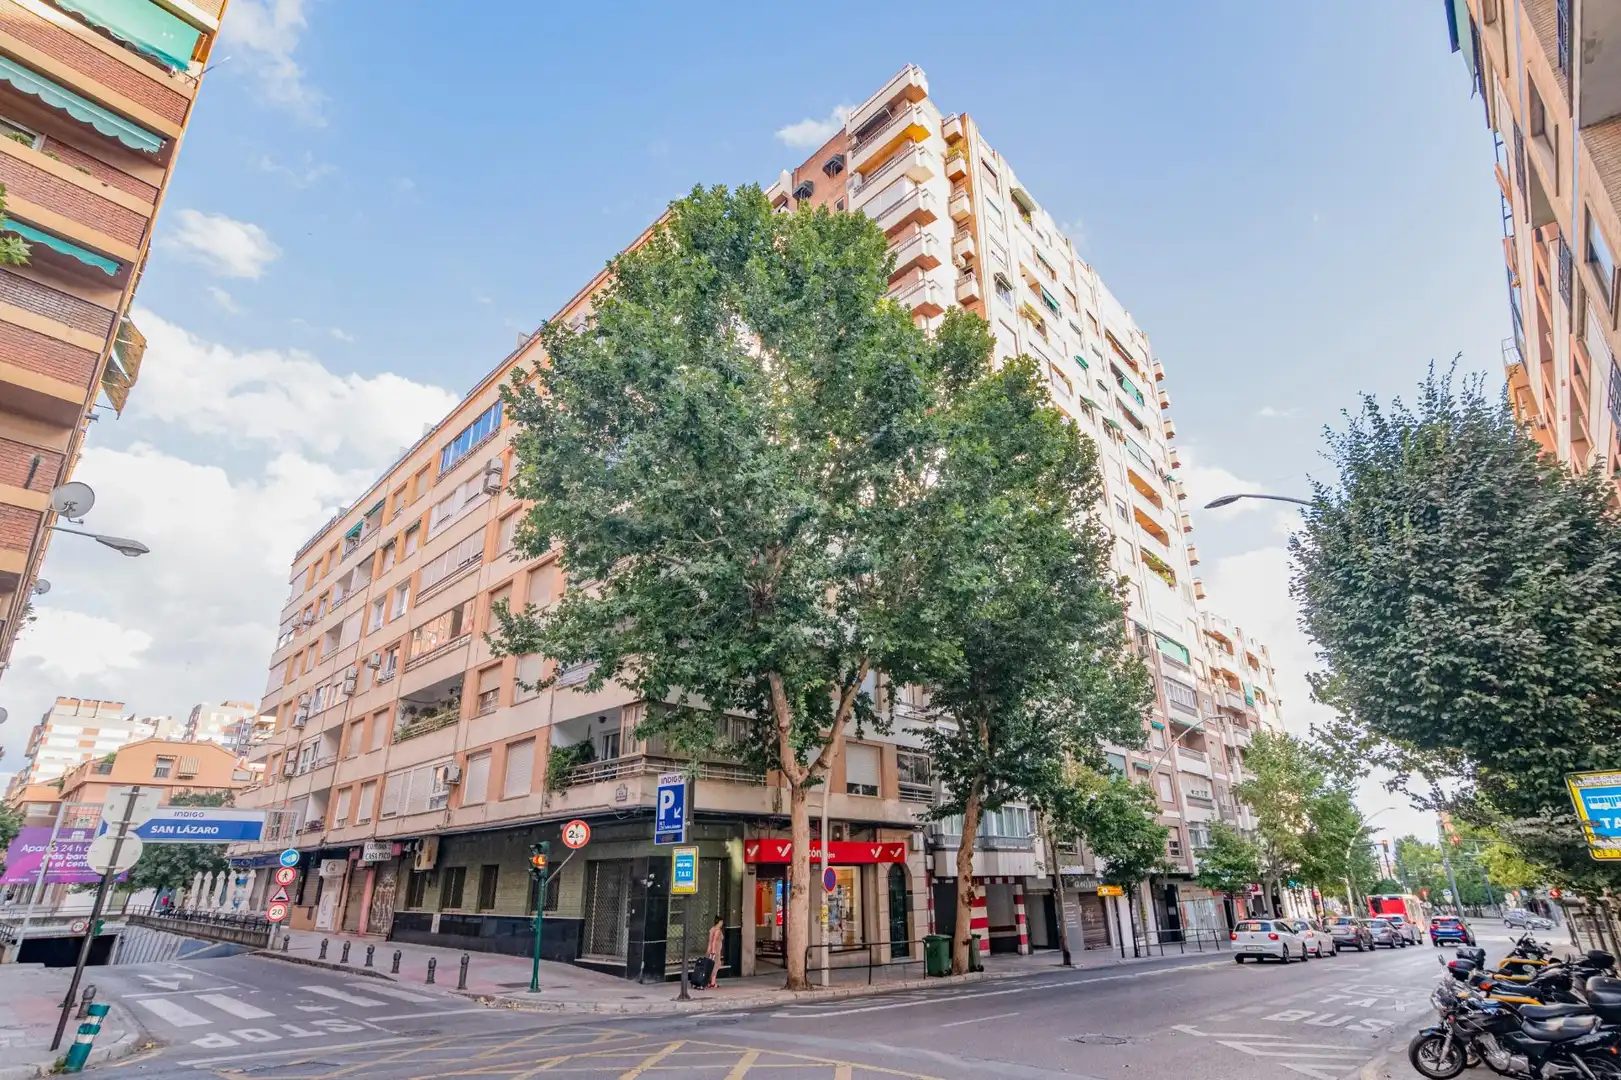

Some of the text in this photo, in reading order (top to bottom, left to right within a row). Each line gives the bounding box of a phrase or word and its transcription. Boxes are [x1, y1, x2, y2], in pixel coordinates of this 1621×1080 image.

[661, 775, 683, 785] INDIGO
[660, 790, 674, 820] P
[173, 811, 205, 819] INDIGO
[1599, 817, 1621, 829] TA
[150, 823, 219, 835] SAN LÁZARO
[20, 843, 59, 854] Apara
[60, 844, 73, 852] 24
[66, 852, 88, 860] bara
[66, 860, 89, 868] cent
[678, 870, 691, 878] TAXI
[271, 908, 283, 916] 20
[1261, 1009, 1395, 1033] BUS
[190, 1018, 366, 1050] STOP
